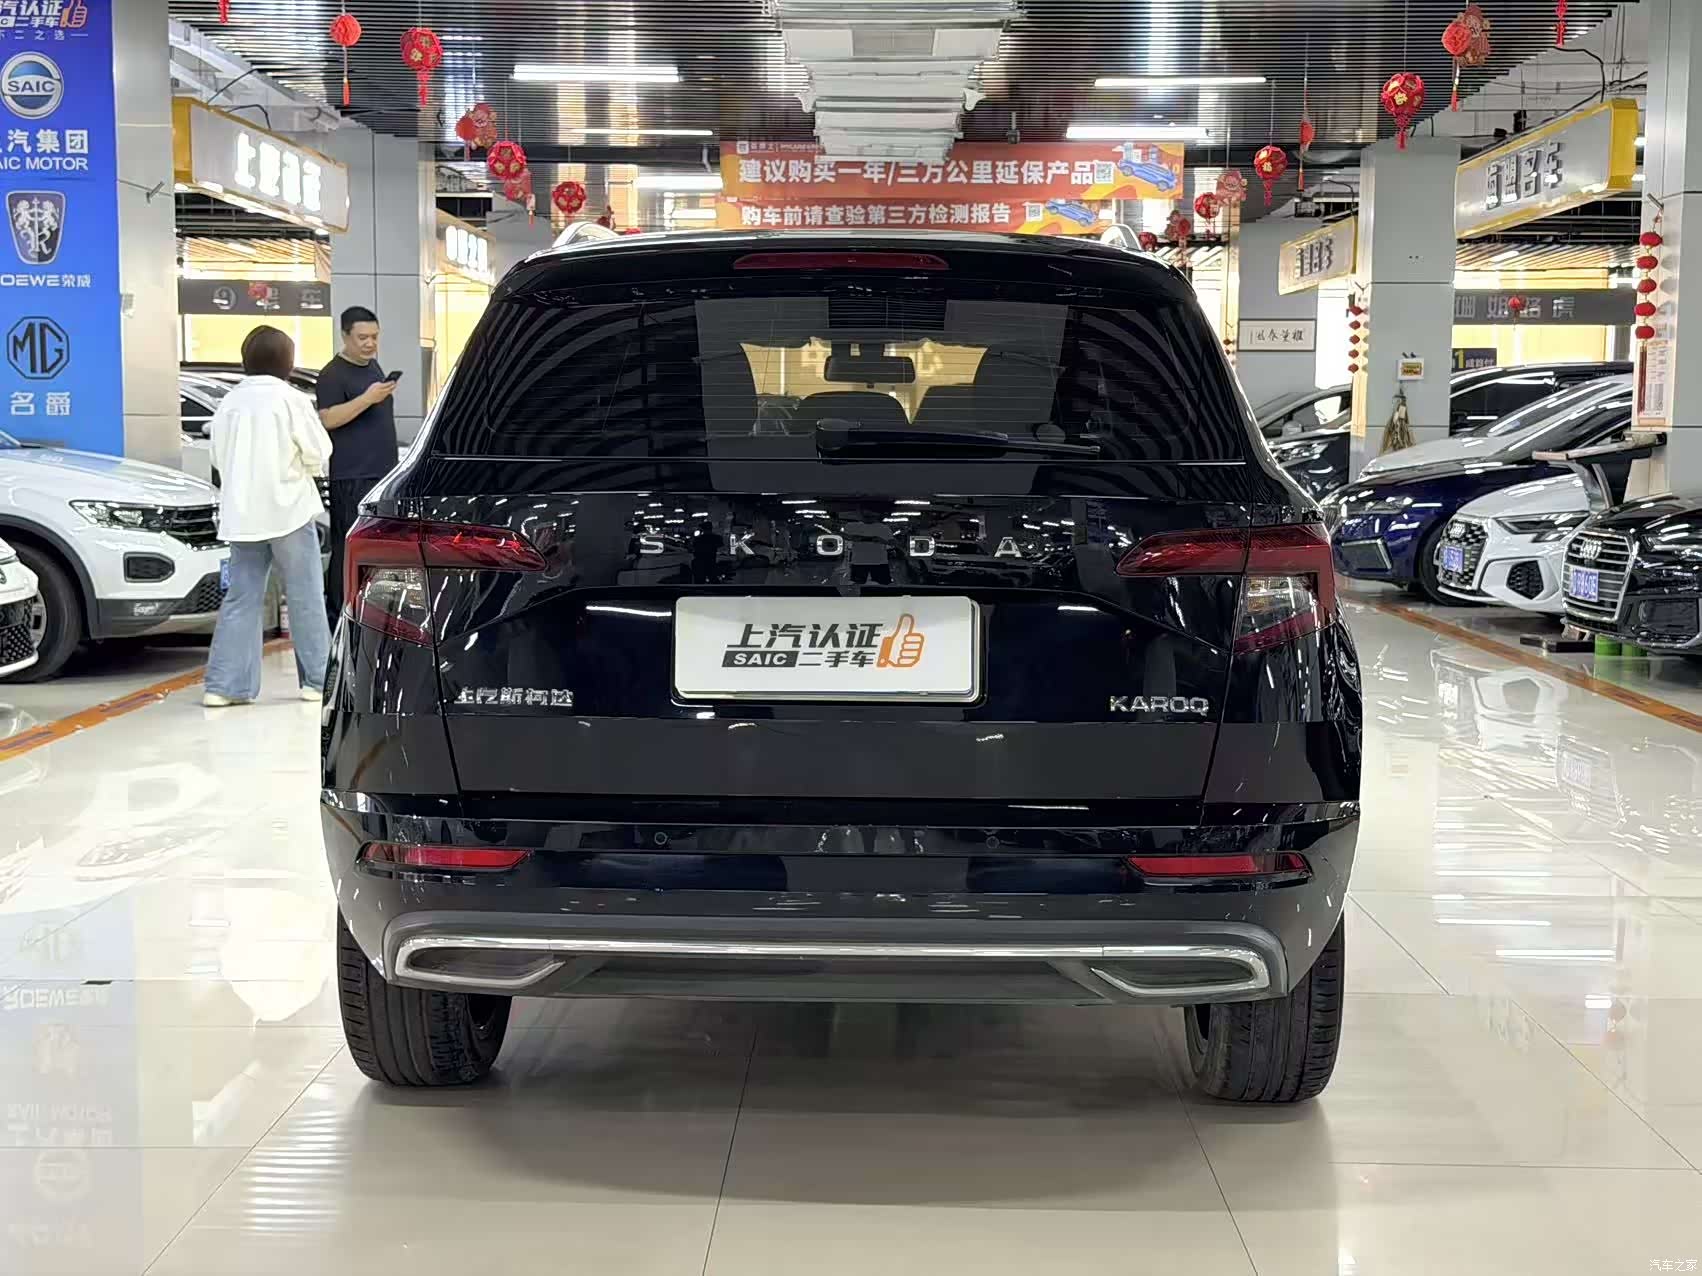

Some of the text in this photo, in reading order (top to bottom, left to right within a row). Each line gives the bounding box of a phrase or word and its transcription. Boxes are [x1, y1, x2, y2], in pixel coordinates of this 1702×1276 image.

[8, 80, 56, 93] SAIC
[0, 128, 89, 154] 汽集团
[26, 156, 89, 170] MOTOR
[739, 158, 1093, 186] 建议购买一年/三万公里延保产品
[742, 203, 1011, 226] 购车前请查验第三方检测报告
[13, 322, 64, 374] MG
[10, 391, 71, 416] 名爵
[727, 623, 883, 648] 上汽认证
[733, 650, 876, 668] SAIC 二手车
[1110, 695, 1209, 717] KAROQ
